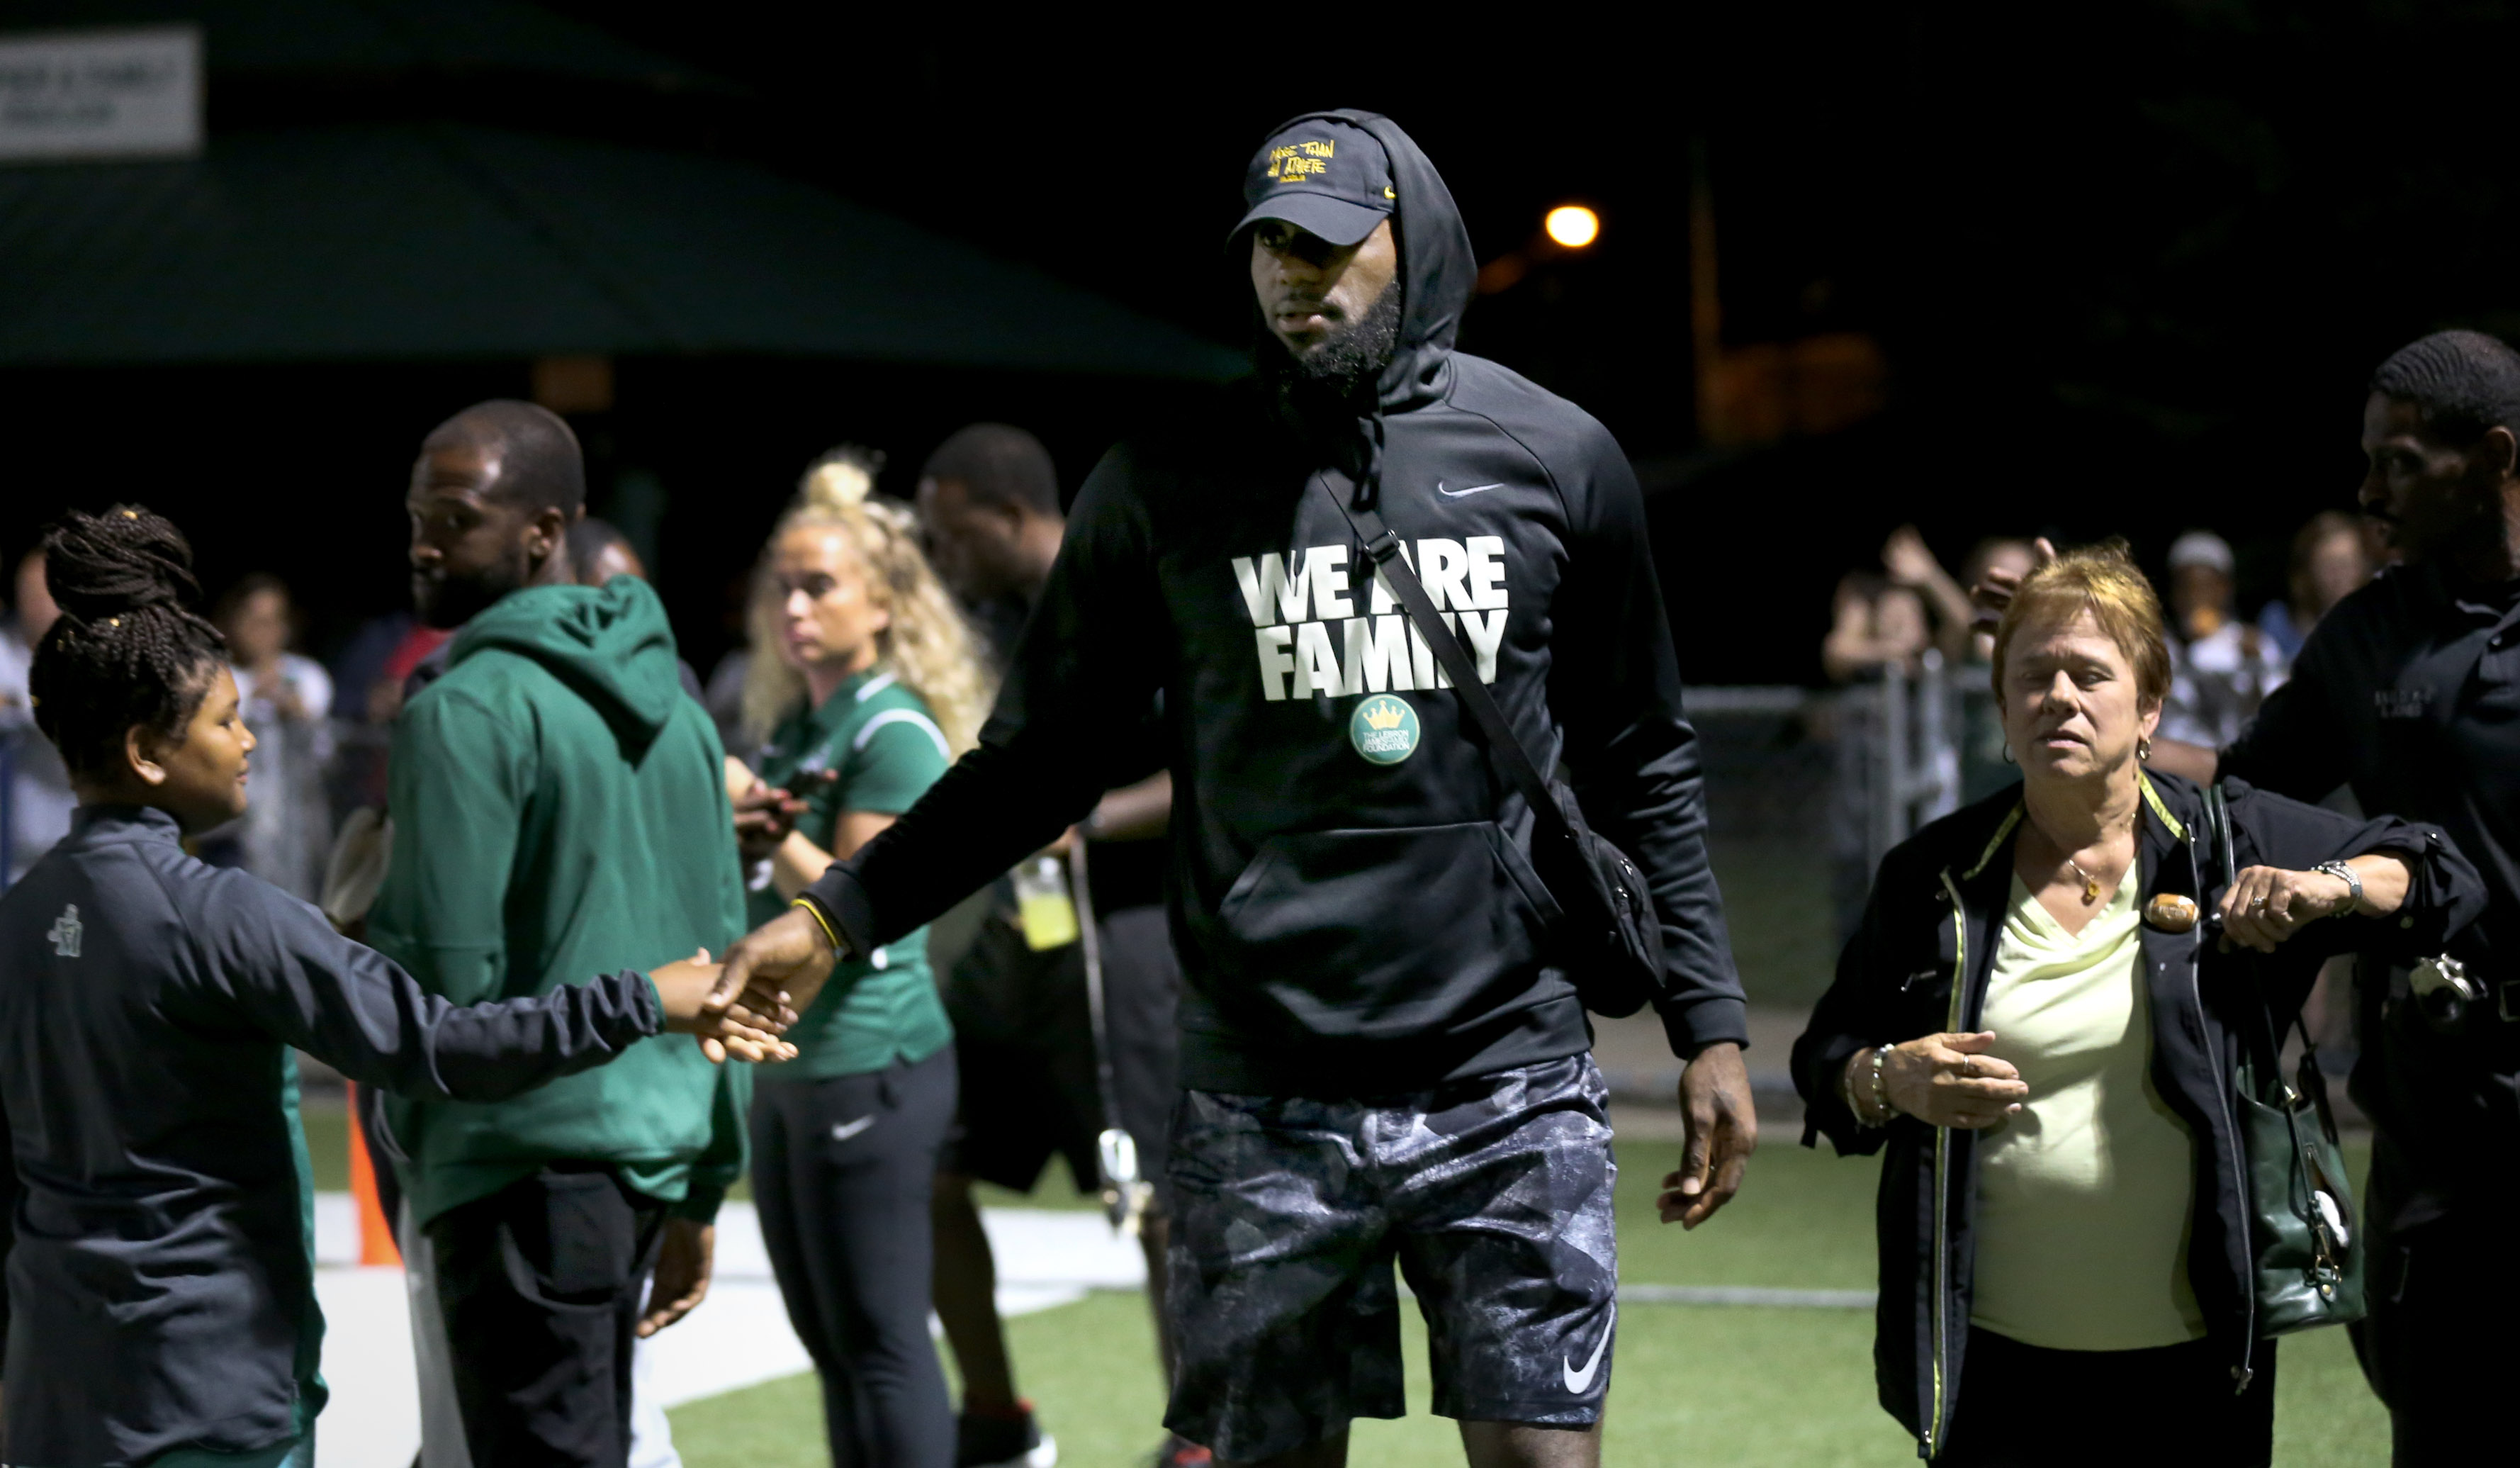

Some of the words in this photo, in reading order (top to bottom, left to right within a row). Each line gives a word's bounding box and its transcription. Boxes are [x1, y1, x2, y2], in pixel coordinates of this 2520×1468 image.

[1299, 139, 1334, 158] THAN
[1284, 156, 1327, 174] ATHLETE
[1231, 544, 1355, 627] WE
[1378, 729, 1409, 739] LEBRON
[1362, 742, 1410, 753] FOUNDATION
